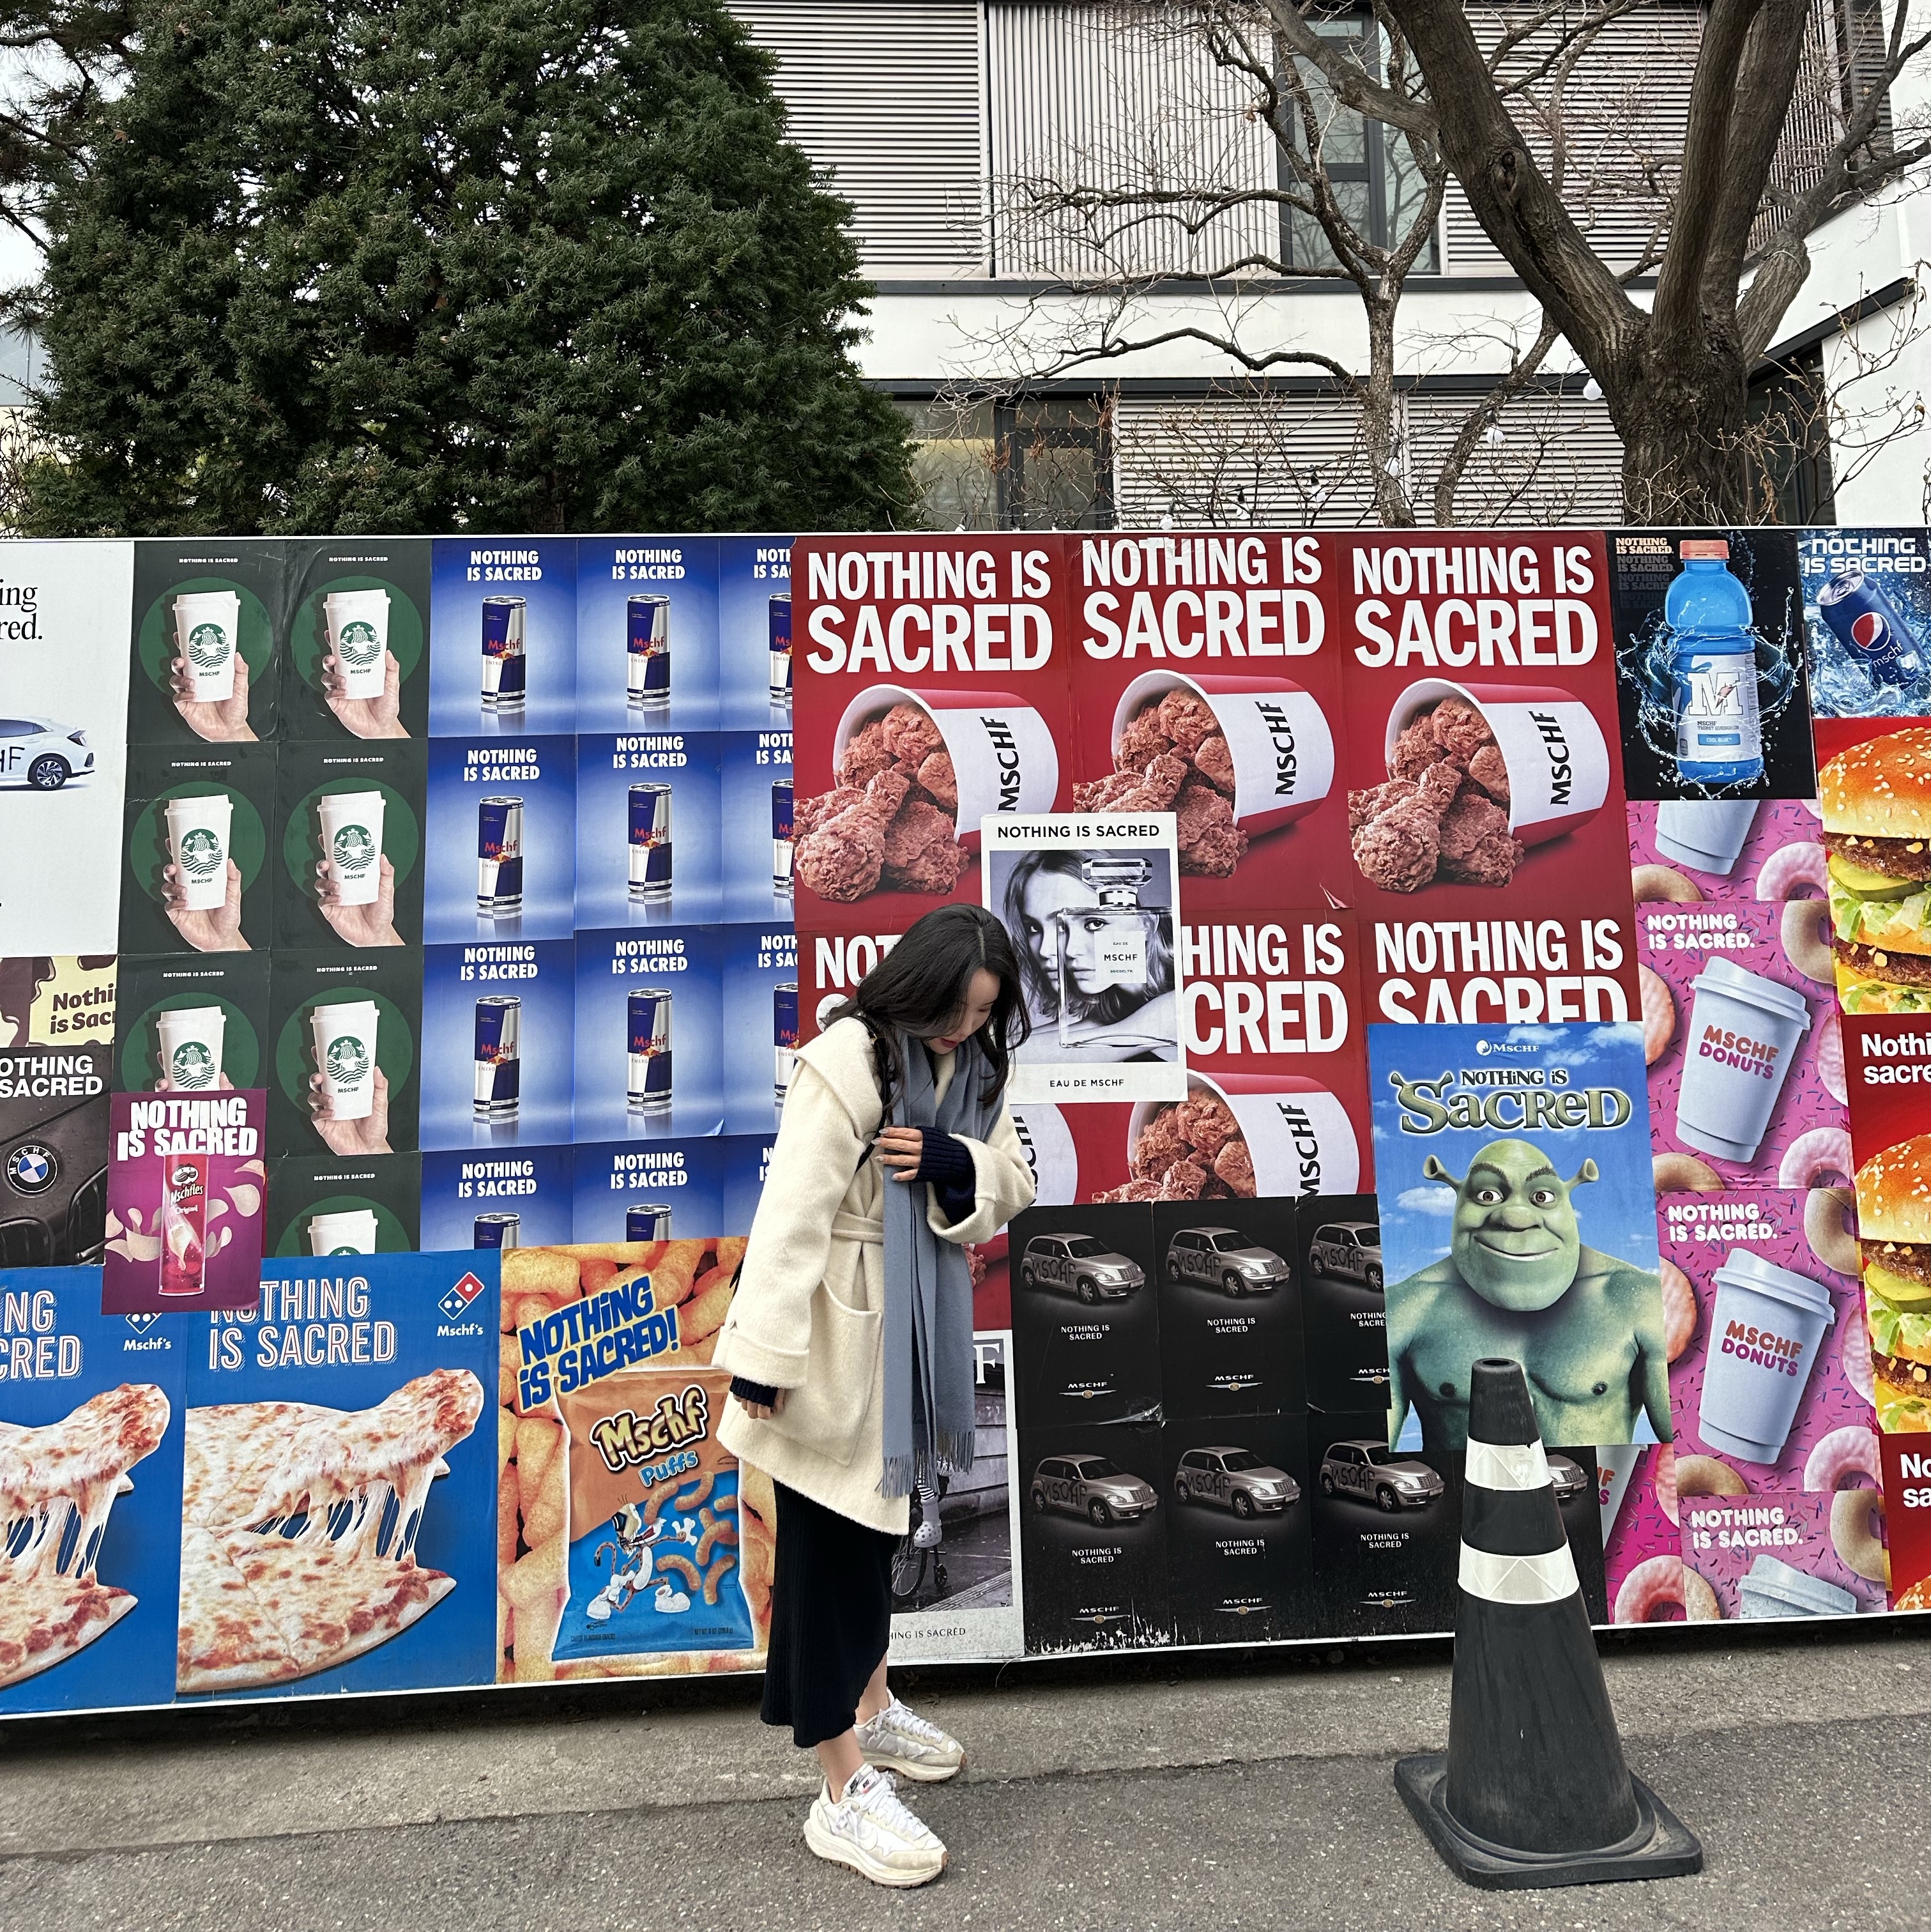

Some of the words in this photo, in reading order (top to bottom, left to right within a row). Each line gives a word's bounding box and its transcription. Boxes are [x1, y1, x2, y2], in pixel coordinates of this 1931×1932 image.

[1615, 538, 1667, 548] NOTHING
[1616, 546, 1627, 555] IS
[471, 551, 538, 564] NOTHING
[616, 549, 682, 563] NOTHING
[1083, 537, 1267, 586] NOTHING
[1282, 537, 1322, 583] IS
[1805, 557, 1824, 574] IS
[1830, 556, 1927, 574] SACRED
[468, 567, 480, 581] IS
[485, 567, 542, 581] SACRED
[613, 566, 625, 579] IS
[630, 565, 685, 579] SACRED
[809, 551, 996, 600] NOTHING
[1012, 551, 1050, 598] IS
[1353, 547, 1539, 595] NOTHING
[1553, 546, 1594, 594] IS
[1083, 590, 1324, 659] SACRED
[1355, 599, 1598, 667] SACRED
[488, 638, 521, 650] Mschf
[633, 636, 665, 649] Mschf
[807, 604, 1052, 673] SACRED
[1872, 641, 1905, 668] mschf
[617, 736, 683, 751] NOTHING
[1255, 702, 1297, 795] MSCHF
[468, 749, 537, 764] NOTHING
[613, 755, 626, 768] IS
[631, 753, 687, 768] SACRED
[980, 717, 1020, 811] MSCHF
[1529, 711, 1571, 805] MSCHF
[464, 767, 477, 781] IS
[482, 766, 540, 781] SACRED
[635, 826, 666, 839] Mschf
[998, 826, 1070, 838] NOTHING
[1077, 826, 1090, 836] IS
[1097, 825, 1159, 836] SACRED
[485, 840, 517, 854] Mschf
[1647, 914, 1737, 930] NOTHING
[616, 939, 684, 956] NOTHING
[1303, 924, 1344, 974] IS
[1375, 920, 1568, 973] NOTHING
[1581, 919, 1622, 970] IS
[1649, 933, 1667, 949] IS
[1674, 933, 1755, 949] SACRED.
[465, 946, 535, 962] NOTHING
[461, 966, 474, 980] IS
[480, 963, 537, 980] SACRED
[613, 959, 625, 974] IS
[630, 957, 687, 973] SACRED
[52, 983, 116, 1012] Nothi
[1378, 977, 1628, 1023] SACRED
[50, 1015, 68, 1034] is
[481, 1041, 515, 1055] Mschf
[634, 1034, 666, 1048] Mschf
[1704, 1025, 1779, 1063] MSCHF
[1699, 1041, 1774, 1080] DONUTS
[130, 1097, 247, 1130] NOTHING
[117, 1130, 146, 1162] IS
[154, 1126, 258, 1157] SACRED
[462, 1161, 533, 1179] NOTHING
[614, 1152, 684, 1170] NOTHING
[459, 1182, 472, 1197] IS
[478, 1179, 537, 1197] SACRED
[611, 1174, 624, 1189] IS
[629, 1170, 687, 1188] SACRED
[1668, 1204, 1759, 1222] NOTHING
[1670, 1225, 1688, 1241] IS
[1695, 1223, 1779, 1243] SACRED.
[437, 1323, 483, 1336] Mschf's
[124, 1337, 171, 1351] Mschf's
[209, 1328, 243, 1370] IS
[257, 1322, 396, 1367] SACRED
[1725, 1319, 1803, 1360] MSCHF
[558, 1308, 682, 1393] SACRED!
[1721, 1338, 1798, 1377] DONUTS
[592, 1386, 708, 1470] Mschf
[1691, 1507, 1784, 1528] NOTHING
[1693, 1531, 1711, 1549] IS
[1719, 1528, 1803, 1547] SACRED.
[1072, 1548, 1111, 1556] NOTHING
[927, 1627, 965, 1637] SACRED
